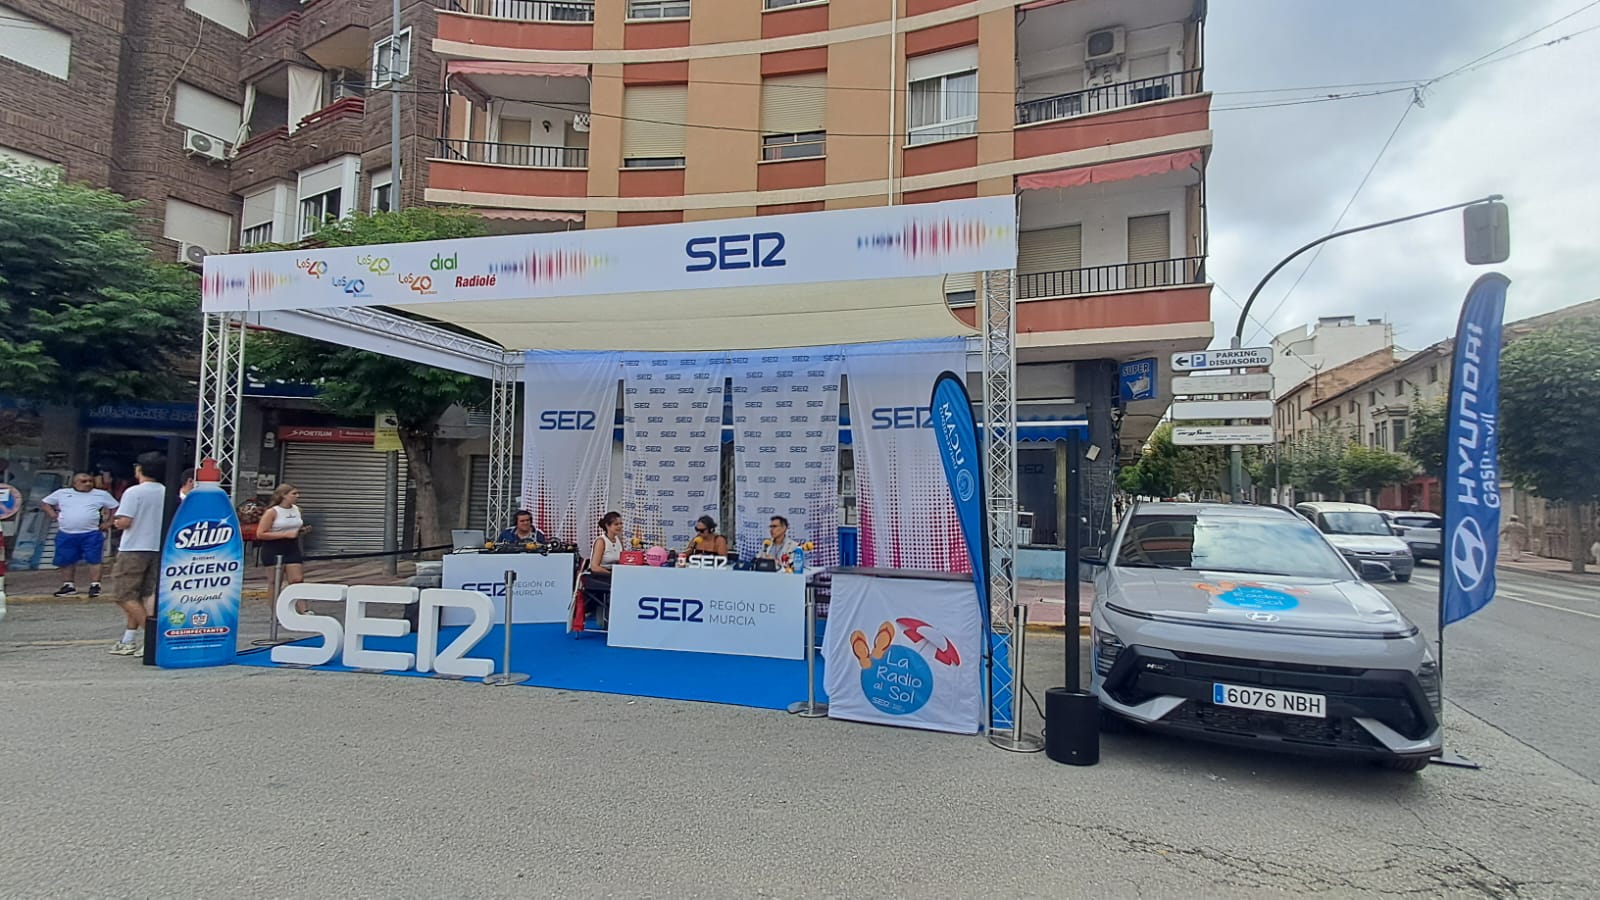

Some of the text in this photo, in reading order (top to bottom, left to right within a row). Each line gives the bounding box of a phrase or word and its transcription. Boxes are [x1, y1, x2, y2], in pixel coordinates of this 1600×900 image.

[686, 231, 786, 272] SER
[430, 252, 457, 270] dial
[455, 274, 496, 288] Radiolé
[1209, 357, 1268, 366] DISUASORIO
[1216, 350, 1257, 358] PARKING
[1122, 363, 1150, 375] SUPER
[539, 411, 596, 430] SER
[872, 407, 934, 430] SER
[1458, 322, 1484, 506] HYUNDAI
[195, 521, 209, 530] LA
[175, 527, 233, 549] SALUD
[166, 561, 238, 577] OXÍGENO
[689, 554, 728, 570] SER
[171, 576, 231, 591] ACTIVO
[181, 592, 222, 604] Original
[638, 597, 776, 623] SER REGIÓN DE
[709, 615, 756, 626] MURCIA
[271, 583, 495, 677] SER
[887, 651, 909, 669] La
[876, 666, 922, 688] Radio
[889, 685, 915, 704] Sol
[1227, 688, 1321, 714] 6076 NBH
